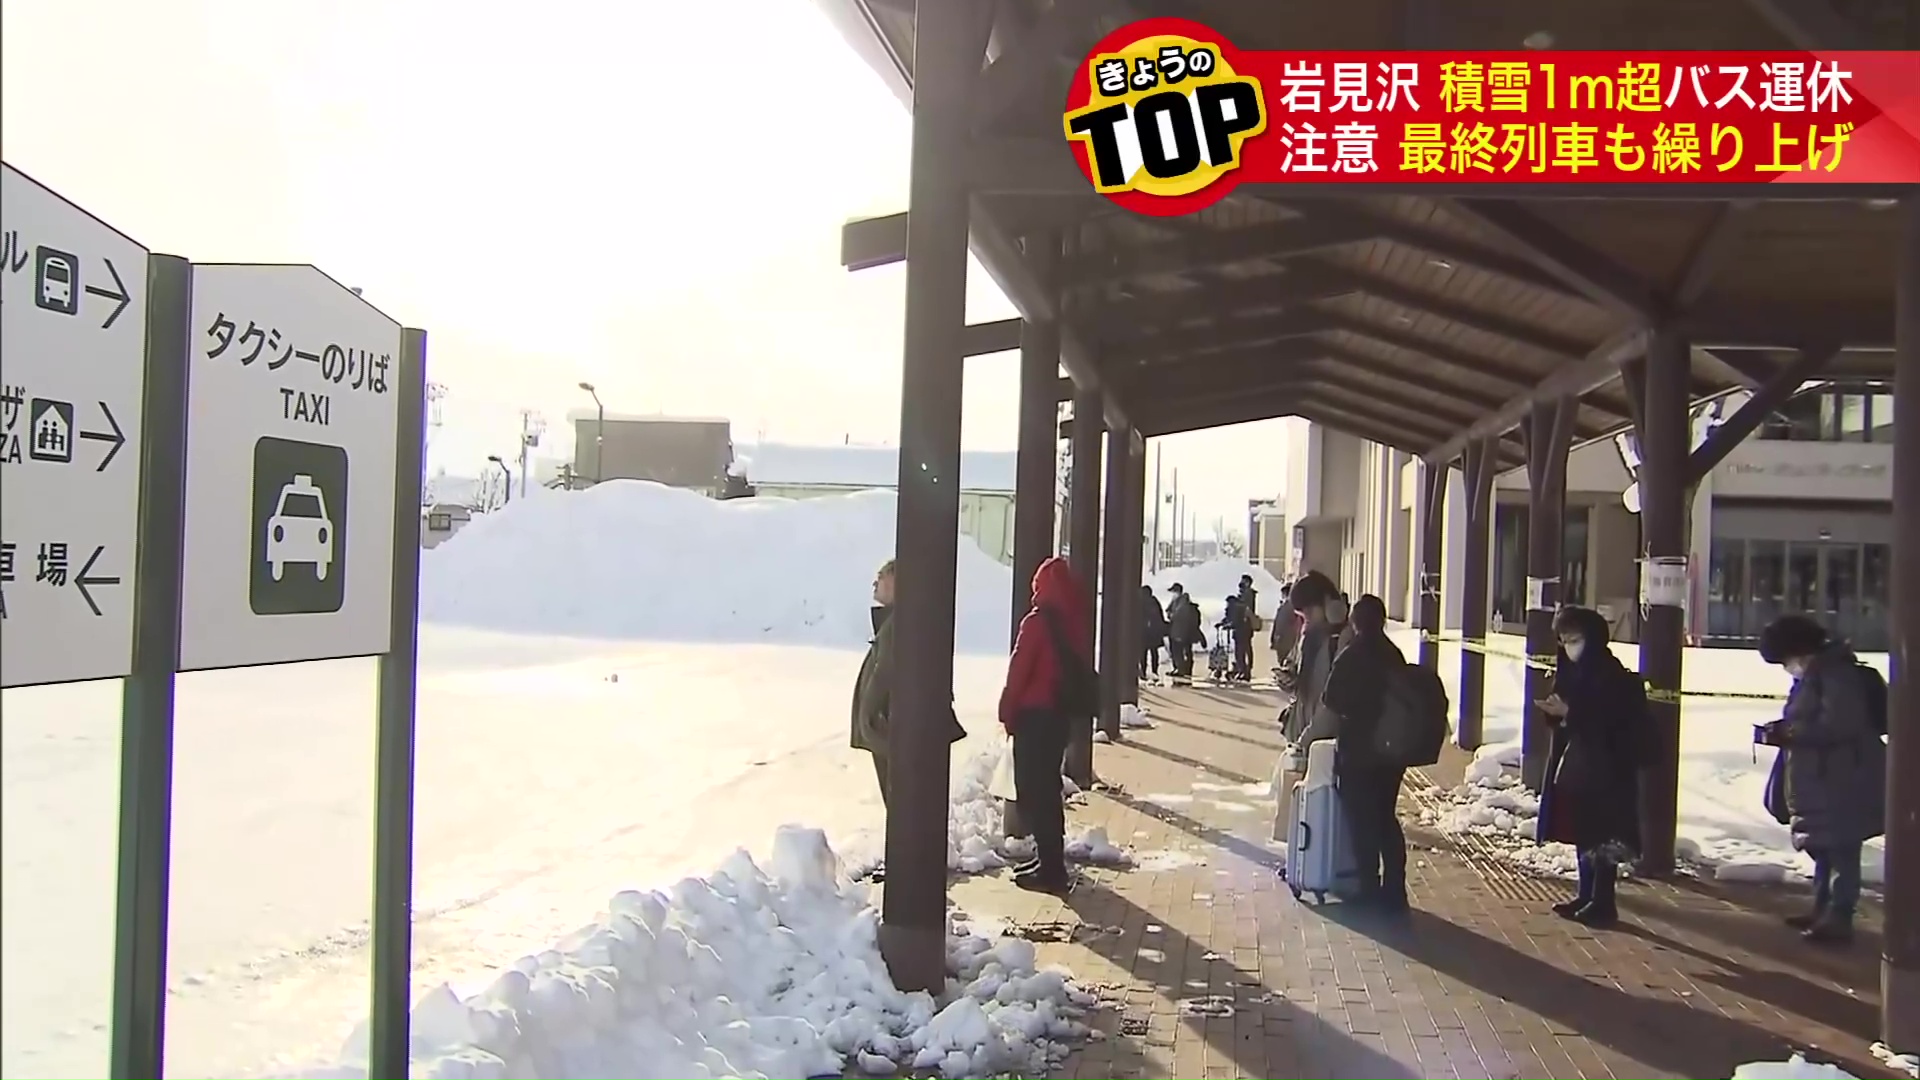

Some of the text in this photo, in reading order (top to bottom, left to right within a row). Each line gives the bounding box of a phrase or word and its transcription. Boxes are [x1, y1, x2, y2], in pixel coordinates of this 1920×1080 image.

[206, 312, 391, 394] タクシーのりば
[280, 387, 329, 426] TAXI
